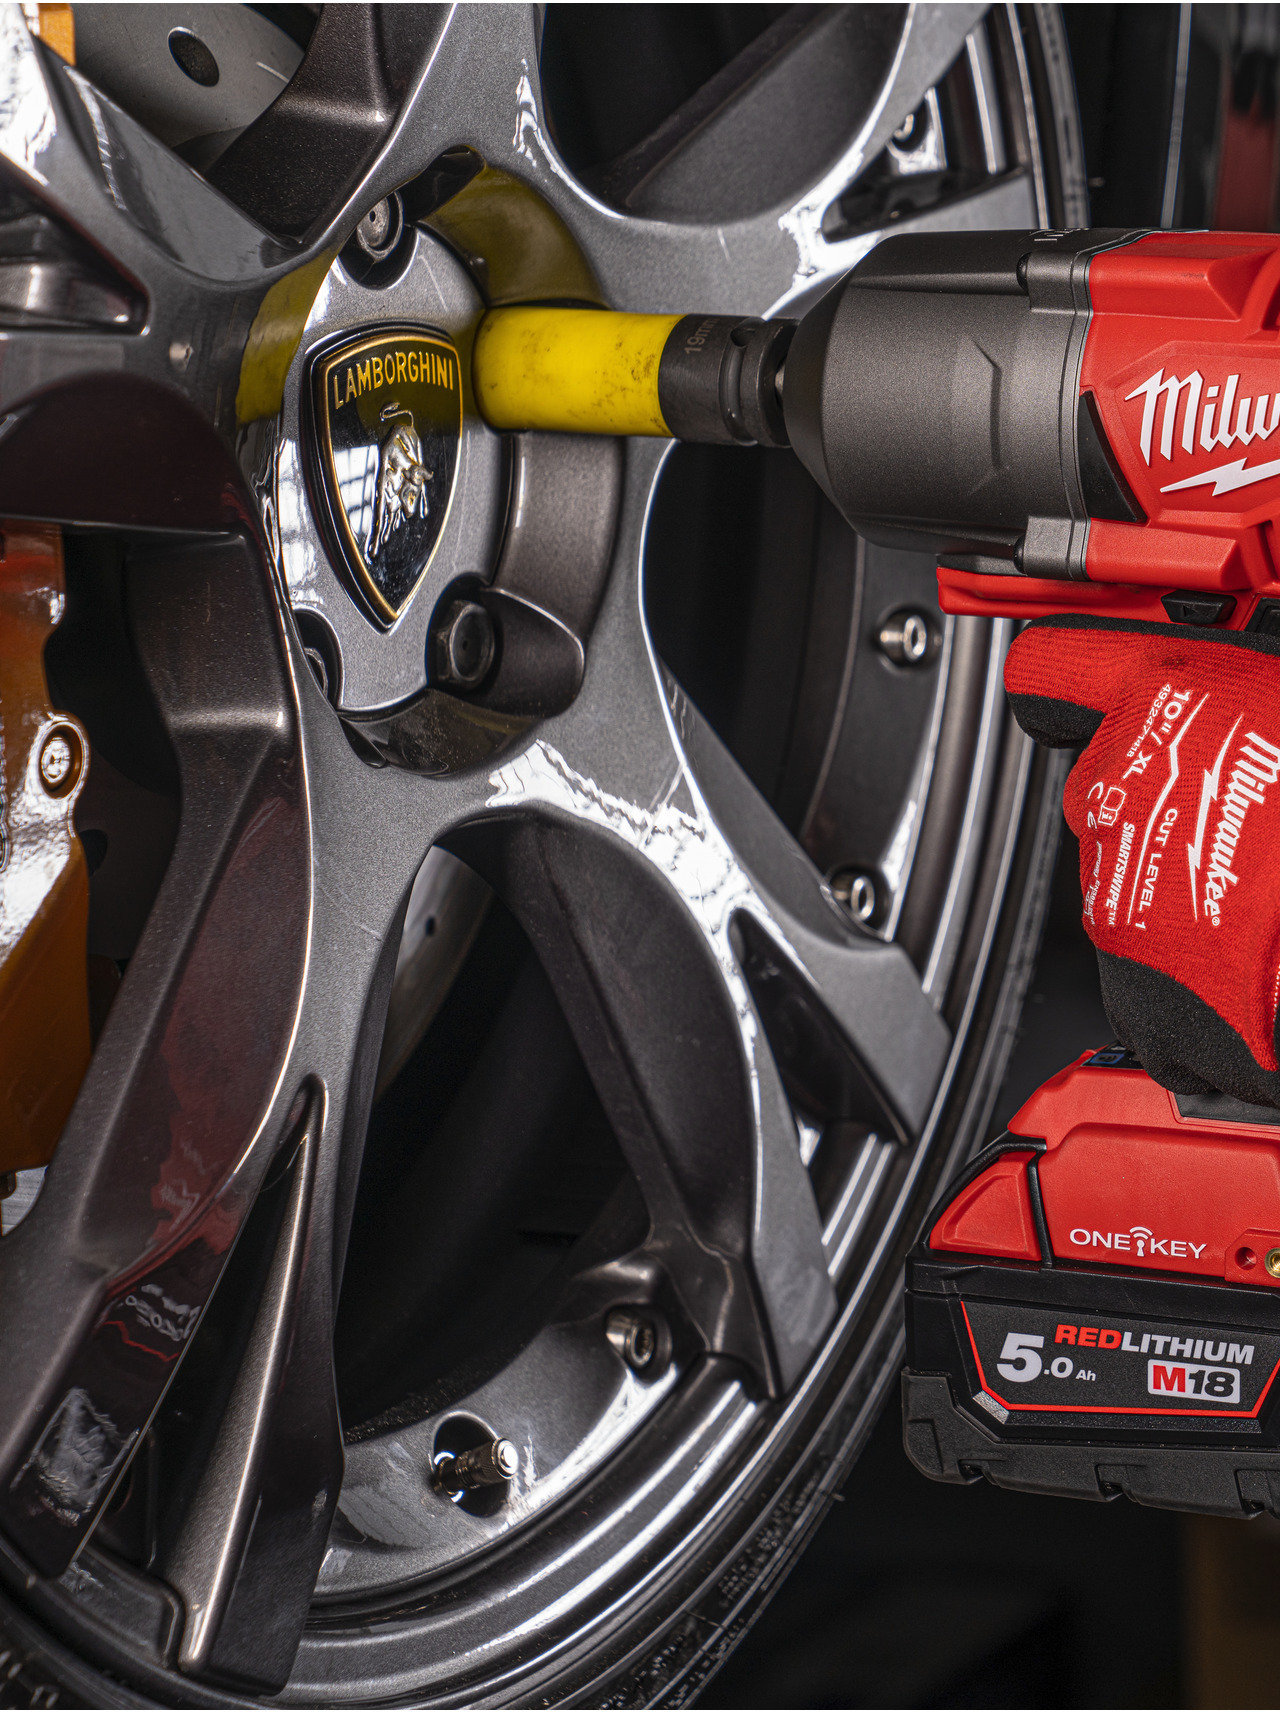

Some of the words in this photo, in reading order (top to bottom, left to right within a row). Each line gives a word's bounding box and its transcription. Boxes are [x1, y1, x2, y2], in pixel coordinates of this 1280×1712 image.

[333, 351, 454, 410] LAMBORGHINI
[1155, 808, 1178, 846] CUT
[1139, 853, 1162, 912] LEVEL
[1135, 921, 1147, 930] 1
[996, 1332, 1074, 1383] 5.0
[1075, 1369, 1097, 1382] Ah
[1054, 1324, 1255, 1365] REDLITHIUM
[1152, 1364, 1234, 1398] M18
